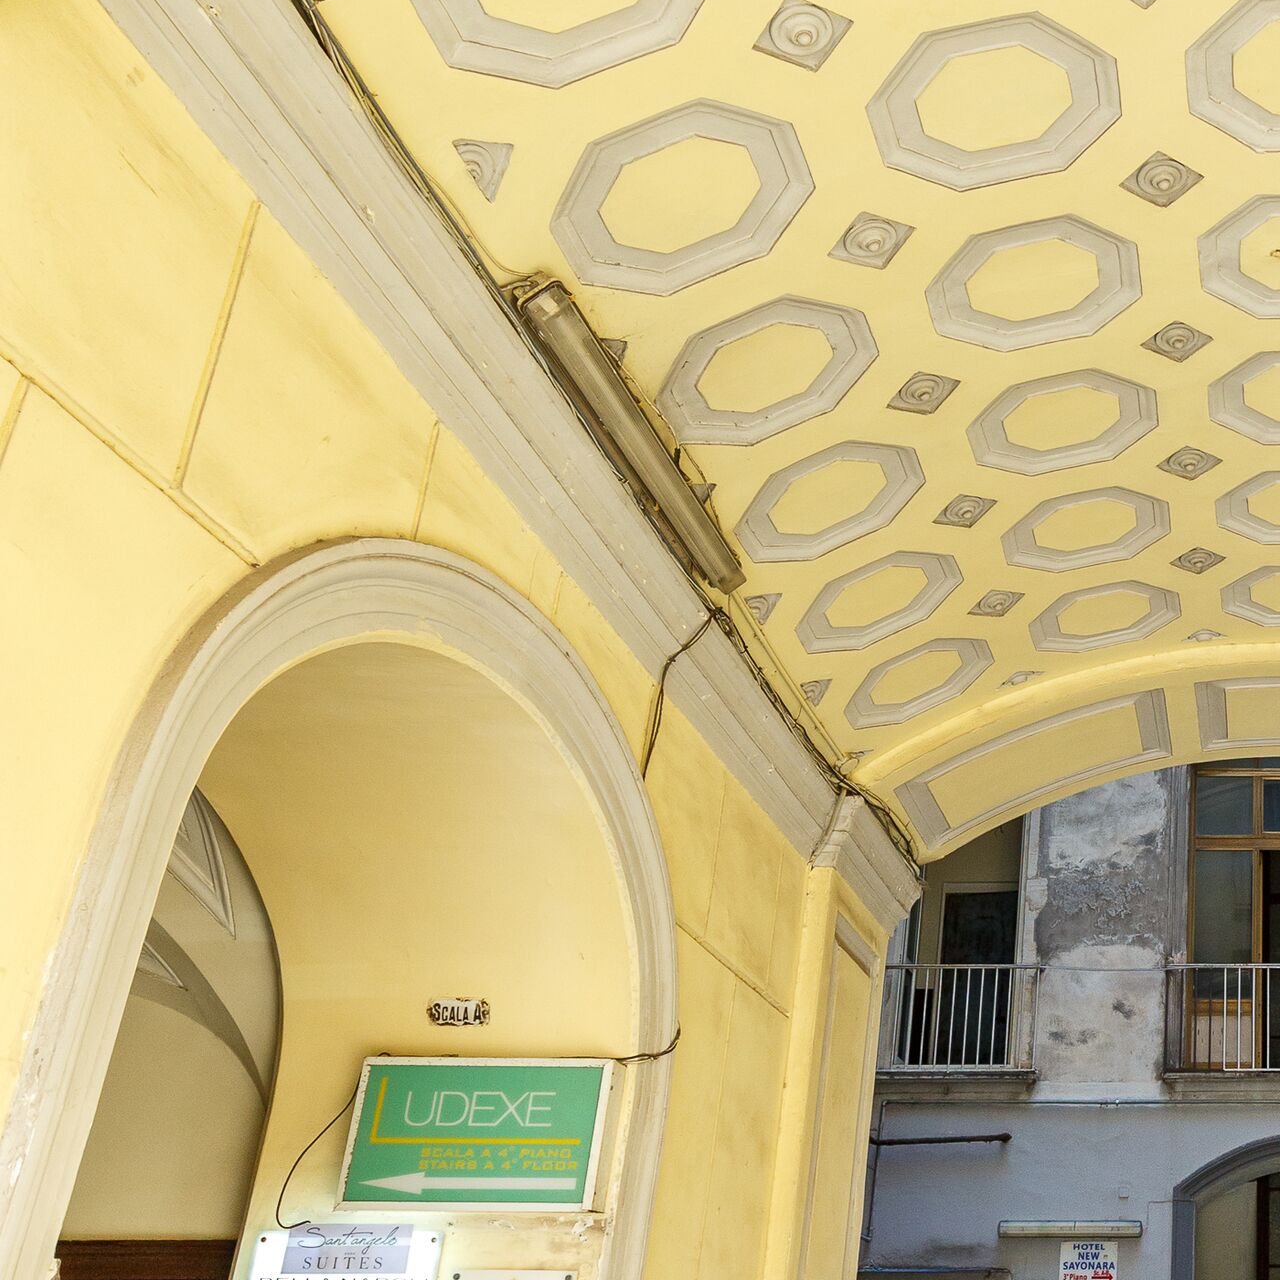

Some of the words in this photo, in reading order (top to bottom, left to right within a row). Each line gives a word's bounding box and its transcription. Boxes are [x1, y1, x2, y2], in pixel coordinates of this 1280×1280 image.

[433, 1003, 469, 1022] SCALA
[473, 1004, 482, 1022] A
[404, 1091, 557, 1127] UDEXE
[420, 1147, 475, 1158] SCALA
[480, 1147, 491, 1158] A
[519, 1147, 573, 1159] PIANO
[418, 1159, 477, 1170] STAIRS
[484, 1160, 494, 1170] A
[522, 1160, 578, 1171] FLOOR
[1073, 1243, 1106, 1251] HOTEL
[1077, 1252, 1100, 1260] NEW
[302, 1256, 384, 1271] SUITES
[1062, 1261, 1116, 1270] SAYONARA
[1069, 1273, 1088, 1280] Piano
